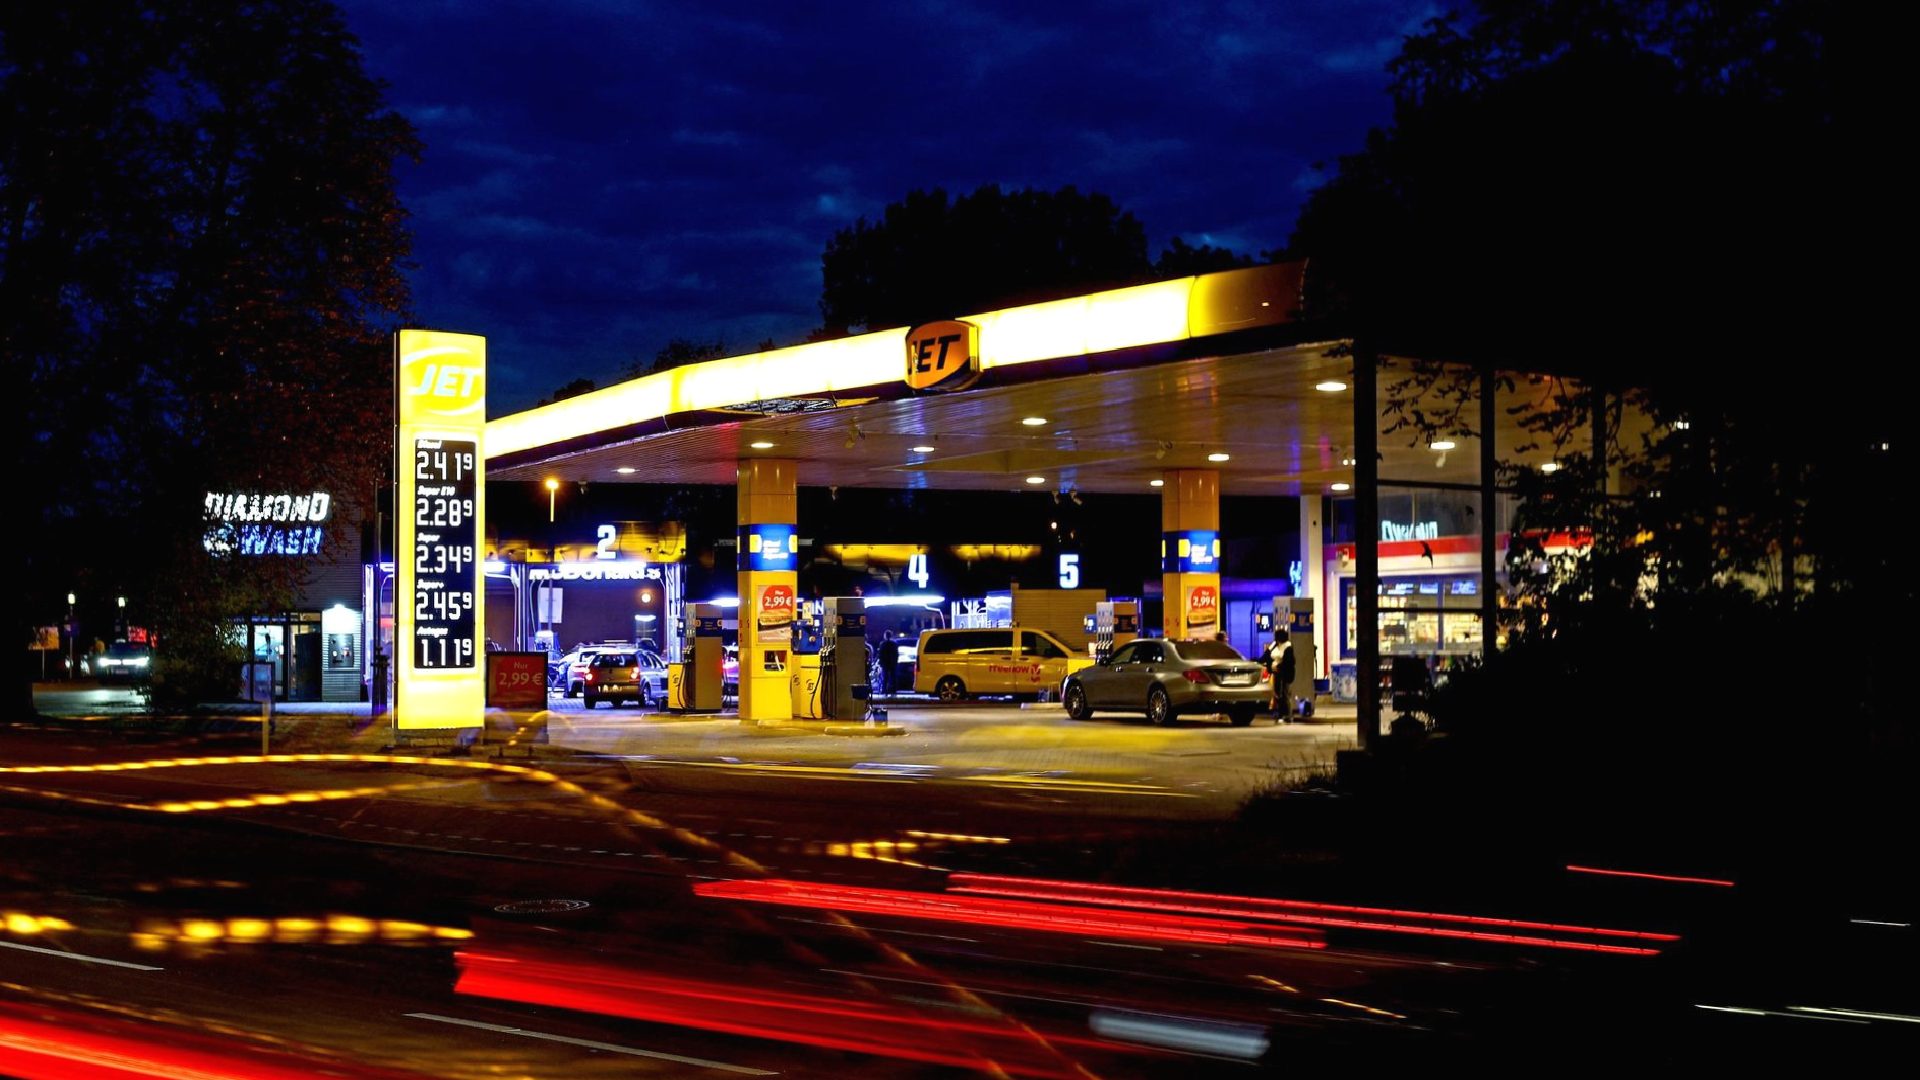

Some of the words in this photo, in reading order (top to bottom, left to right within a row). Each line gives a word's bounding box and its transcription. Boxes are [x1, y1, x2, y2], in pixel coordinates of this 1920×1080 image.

[415, 364, 477, 397] JET
[202, 491, 331, 522] DIAMOND
[416, 497, 473, 527] 2.289
[241, 524, 323, 555] WASH
[596, 524, 617, 560] 2
[416, 545, 473, 574] 2.349
[908, 553, 930, 589] 4
[1059, 553, 1080, 589] 5
[416, 591, 473, 621] 2.459
[763, 596, 785, 608] 2,99
[498, 672, 530, 688] 2,99
[531, 672, 543, 686] €
[513, 661, 528, 669] Nur
